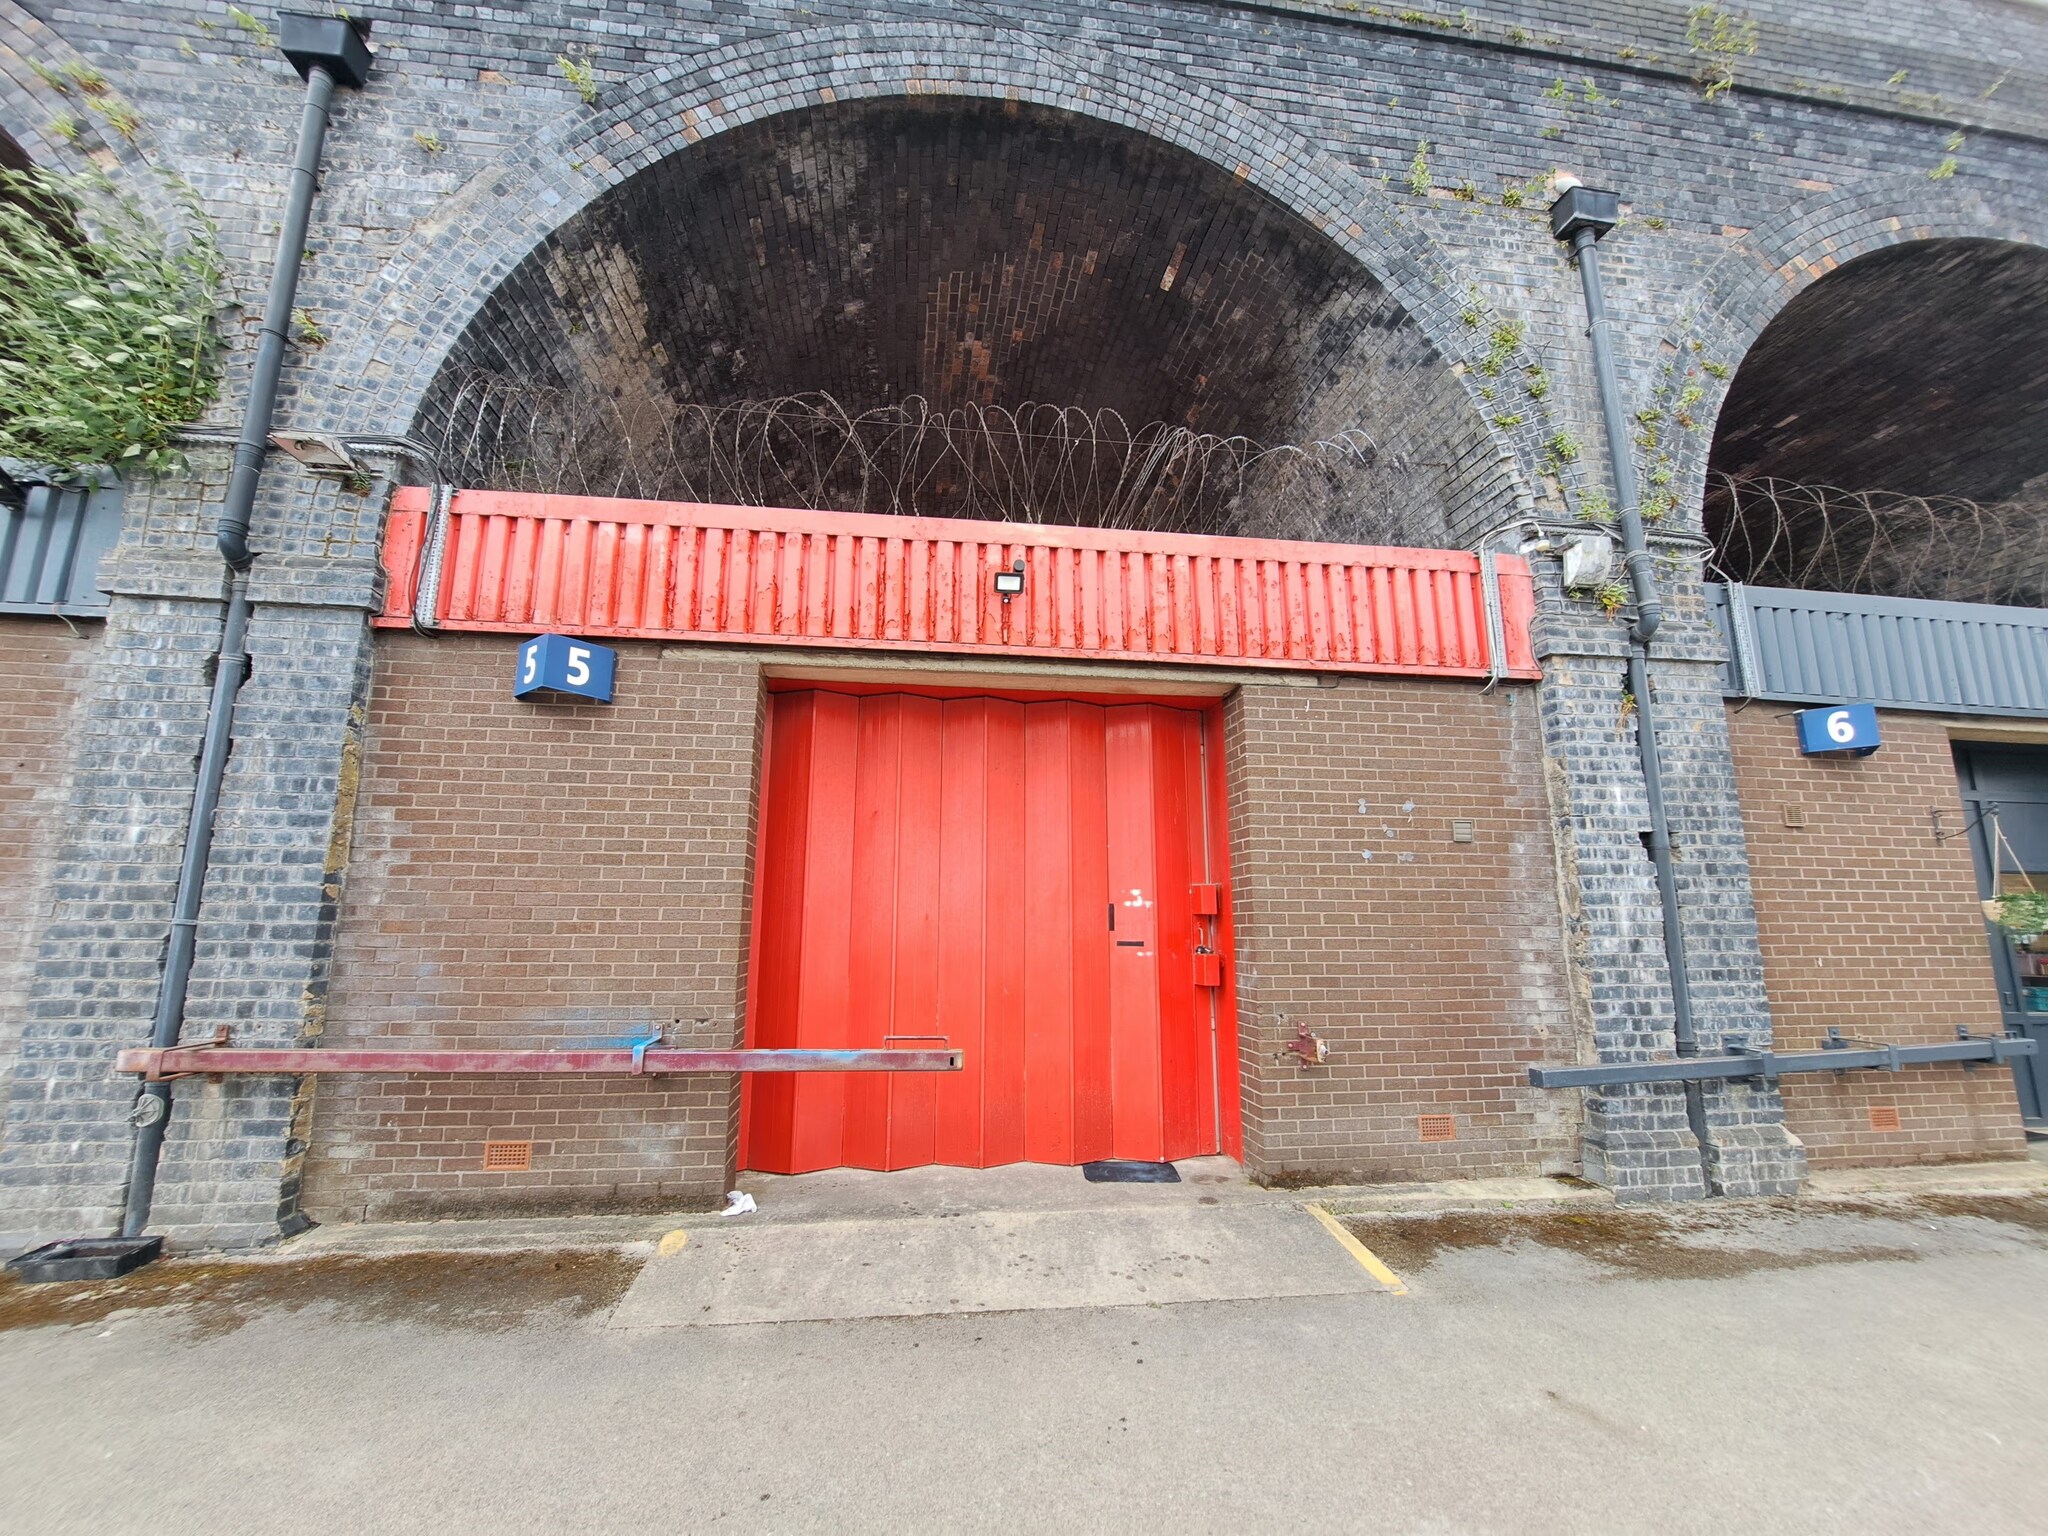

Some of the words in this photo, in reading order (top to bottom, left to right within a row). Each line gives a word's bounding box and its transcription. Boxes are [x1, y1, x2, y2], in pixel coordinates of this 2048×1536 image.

[523, 644, 538, 684] 5
[566, 646, 591, 686] 5
[1826, 710, 1855, 744] 6
